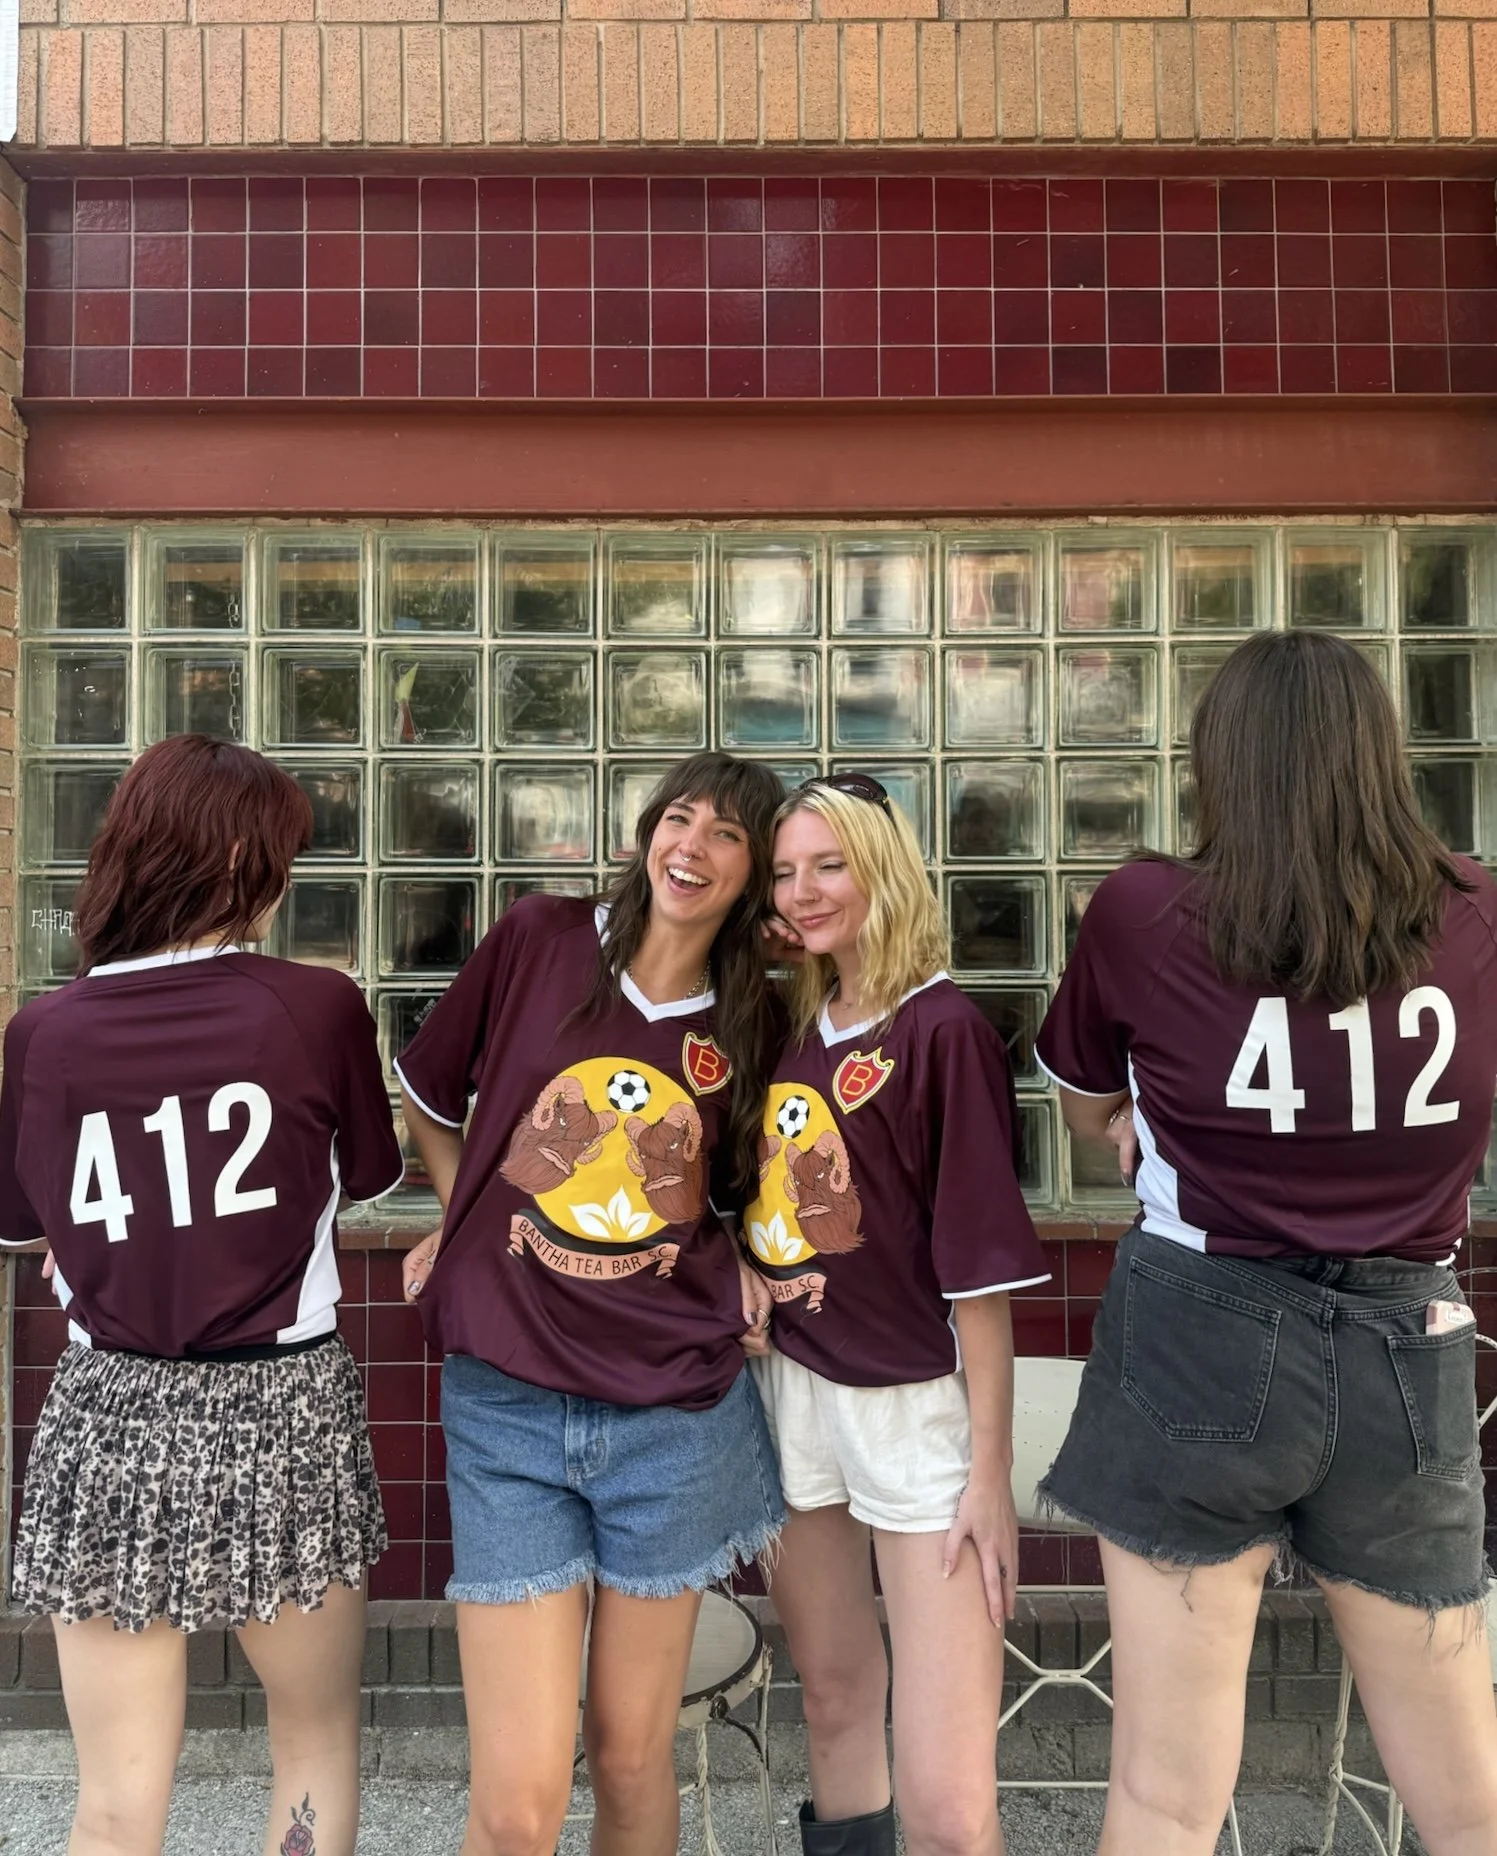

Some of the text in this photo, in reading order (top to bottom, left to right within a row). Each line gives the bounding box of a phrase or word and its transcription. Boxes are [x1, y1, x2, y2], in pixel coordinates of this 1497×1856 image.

[694, 1048, 719, 1081] B
[842, 1064, 873, 1096] B
[1225, 985, 1460, 1133] 412
[69, 1081, 278, 1243] 412
[518, 1219, 569, 1271] BANTHA
[576, 1257, 604, 1276] TEA
[612, 1256, 642, 1275] BAR
[770, 1284, 794, 1299] BAR
